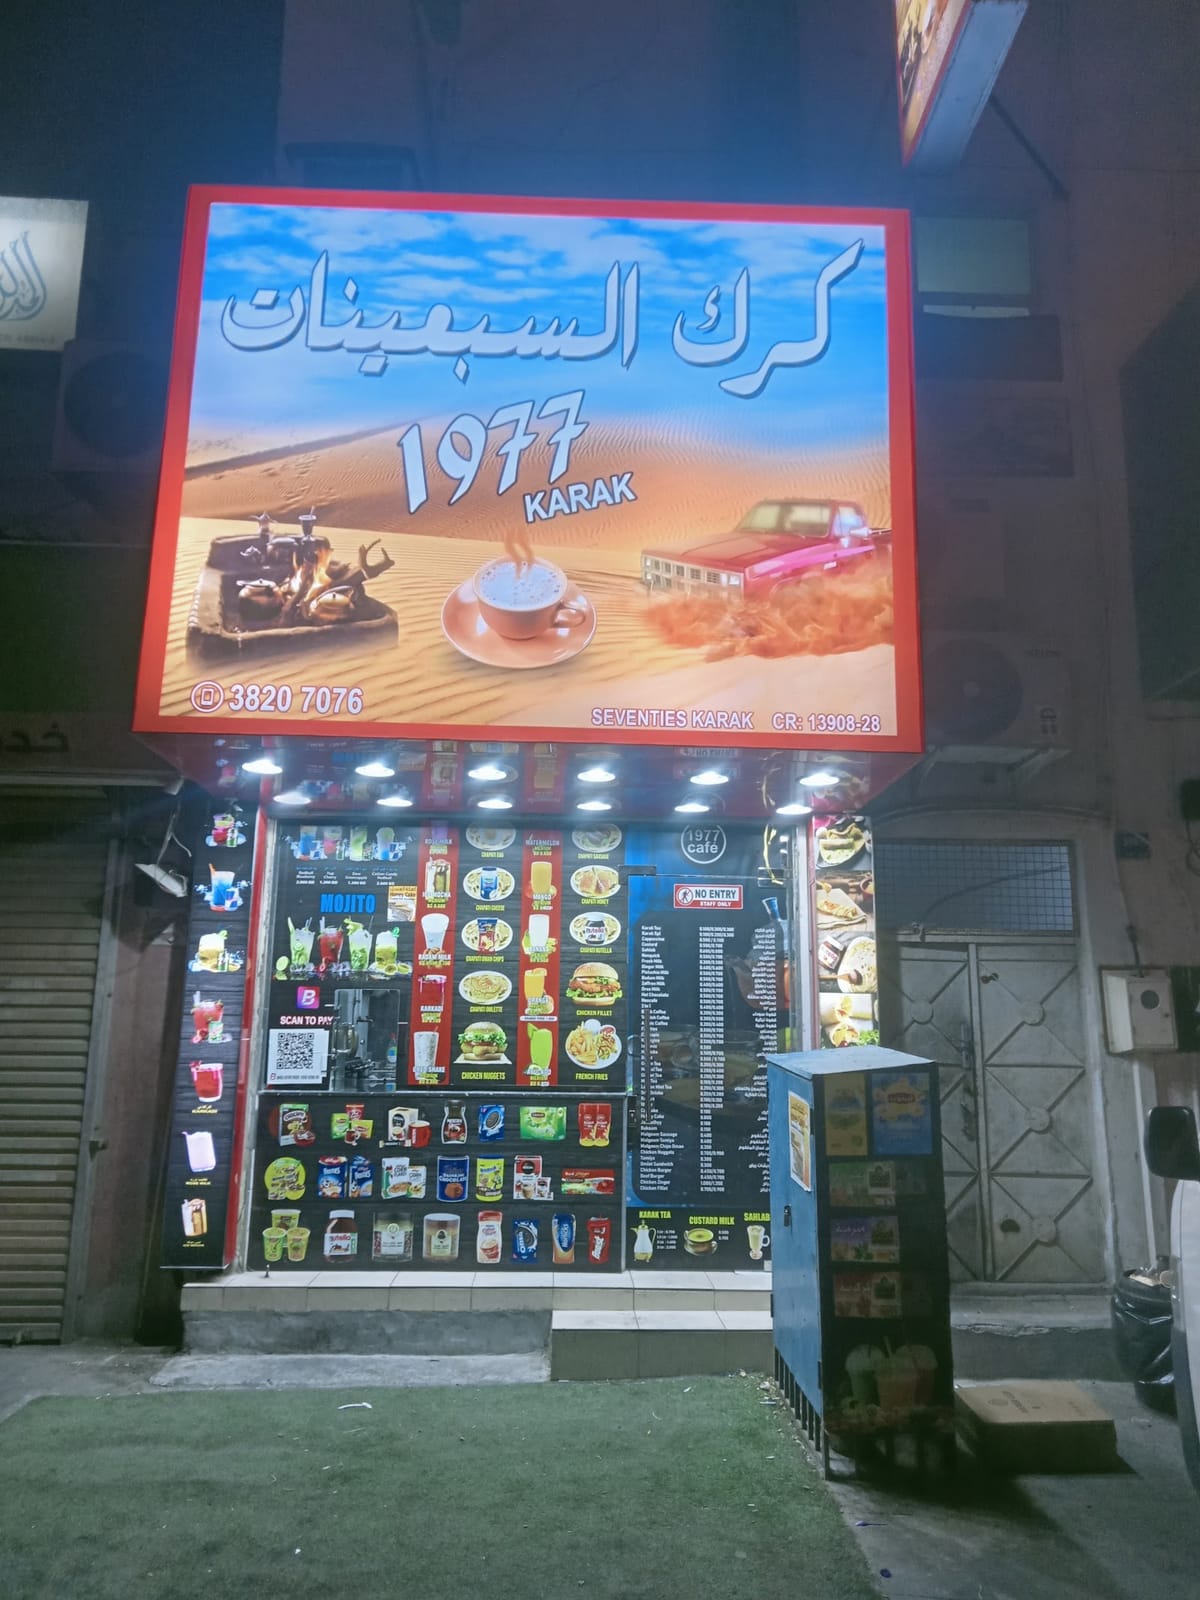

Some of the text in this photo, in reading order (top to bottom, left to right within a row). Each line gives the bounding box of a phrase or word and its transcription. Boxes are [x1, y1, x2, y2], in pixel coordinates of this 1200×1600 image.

[221, 250, 641, 384] السبعينات
[672, 239, 865, 398] كرك
[399, 389, 590, 515] 1977
[522, 472, 637, 524] KARAK
[228, 684, 364, 715] 3820 7076
[591, 708, 881, 732] SEVENTIES KARAK CR: 13908-28
[686, 829, 720, 841] 1977
[320, 893, 376, 914] MOJITO
[694, 889, 736, 899] NO ENTRY
[280, 1016, 334, 1025] SCAN TO PAY
[639, 1211, 659, 1219] KARAK
[689, 1216, 735, 1225] CUSTARD MILK
[744, 1213, 771, 1221] SAHLAB
